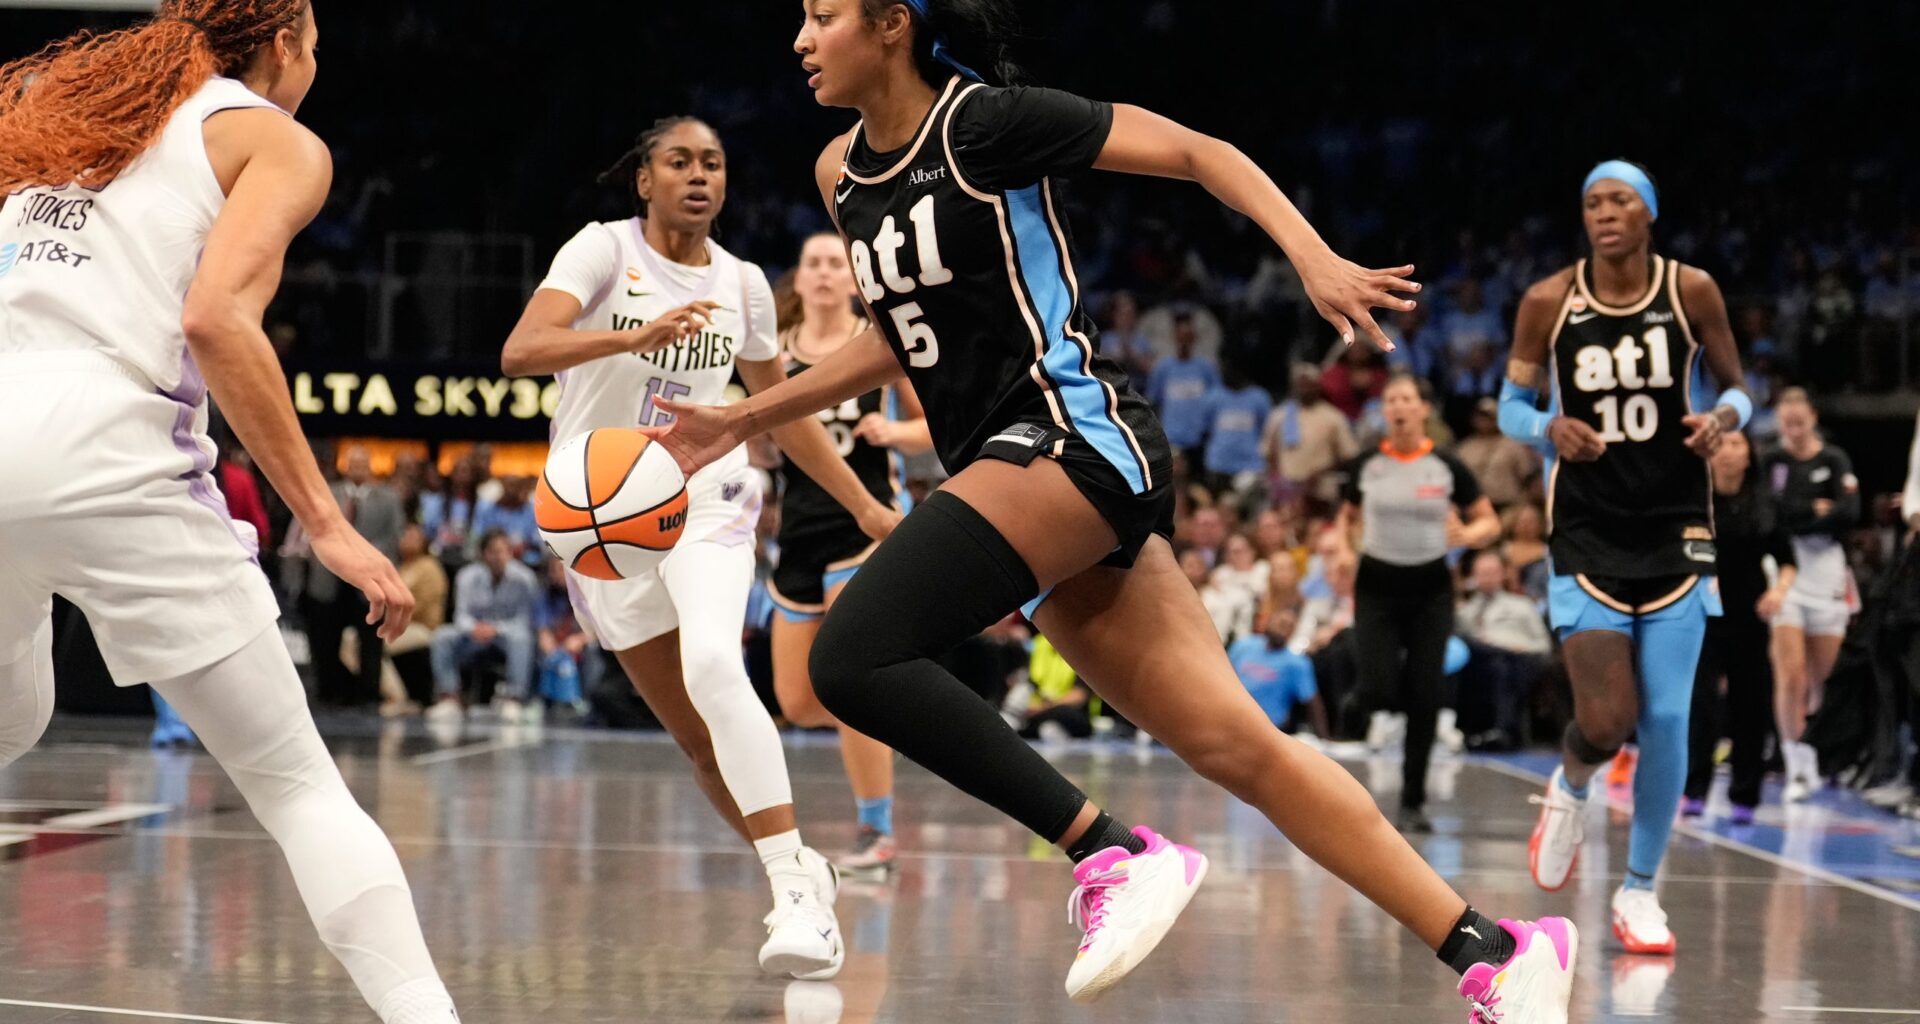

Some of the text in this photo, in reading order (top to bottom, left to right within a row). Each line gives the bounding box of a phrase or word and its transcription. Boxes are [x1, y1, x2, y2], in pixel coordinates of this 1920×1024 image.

[908, 165, 946, 186] Albert
[17, 192, 94, 232] STOKES
[15, 239, 92, 268] AT&T
[612, 313, 733, 373] YRIES
[888, 301, 939, 368] 5
[1593, 393, 1659, 443] 10
